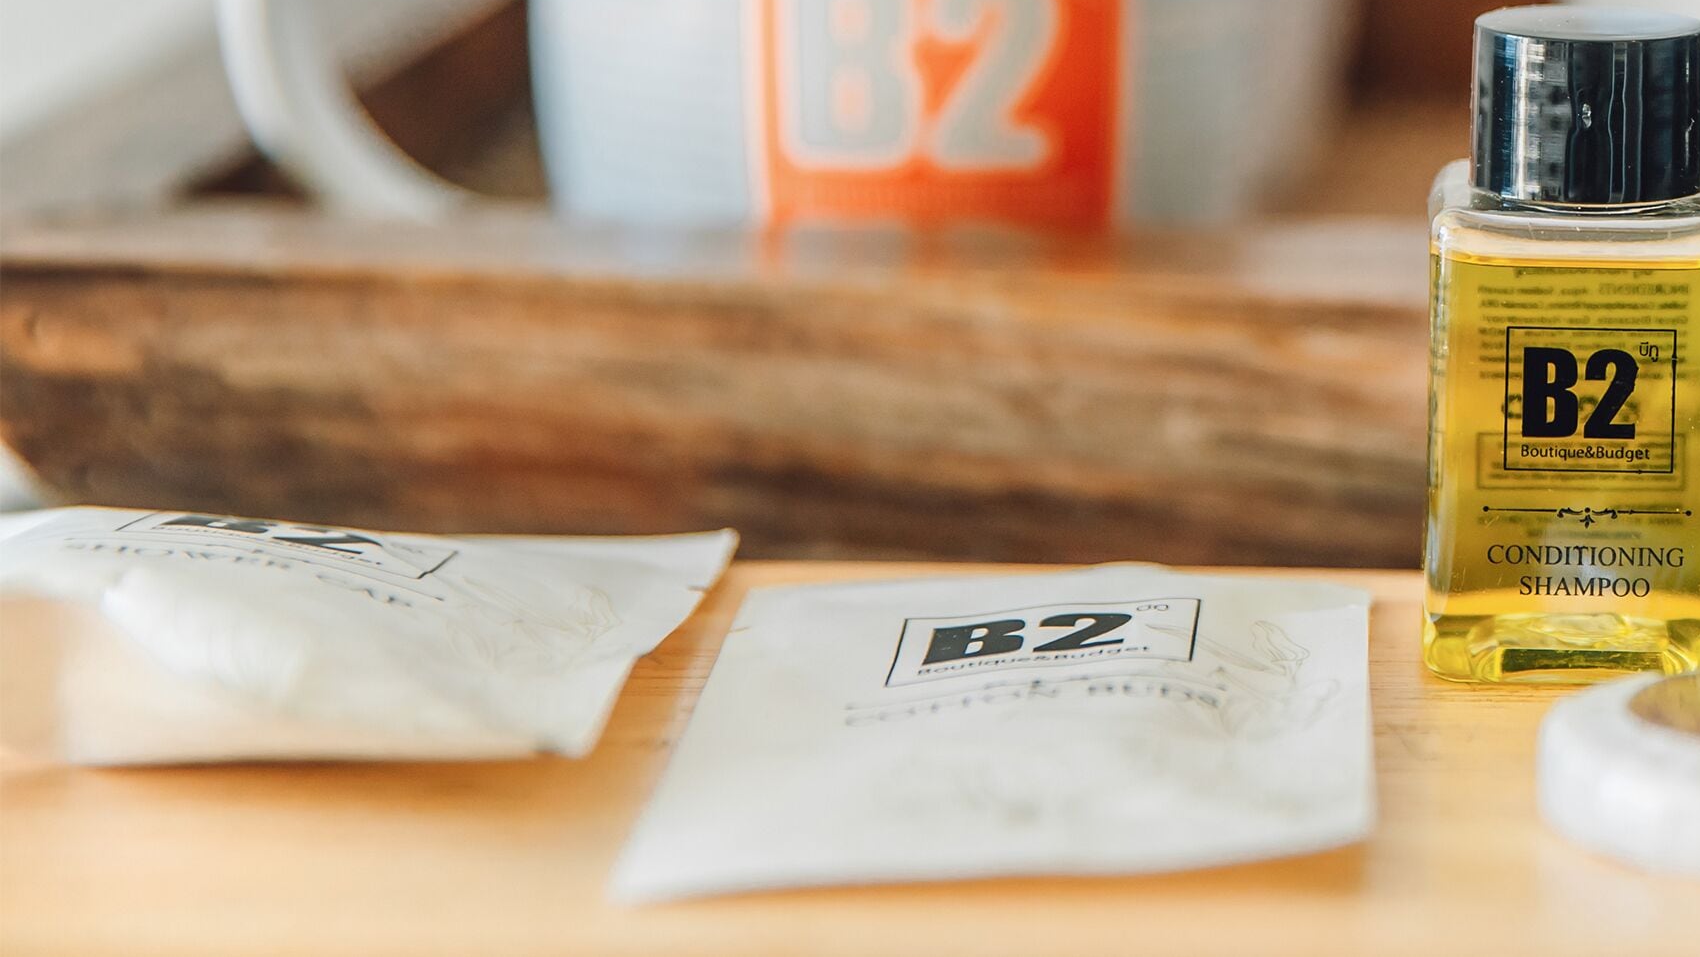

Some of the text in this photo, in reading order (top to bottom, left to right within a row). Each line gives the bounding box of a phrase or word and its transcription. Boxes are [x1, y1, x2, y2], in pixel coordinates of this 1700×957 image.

[1521, 346, 1640, 440] B2
[1520, 444, 1651, 463] Boutique&Budget
[1486, 544, 1685, 568] CONDITIONING
[1518, 575, 1651, 598] SHAMPOO
[921, 612, 1133, 666] B2
